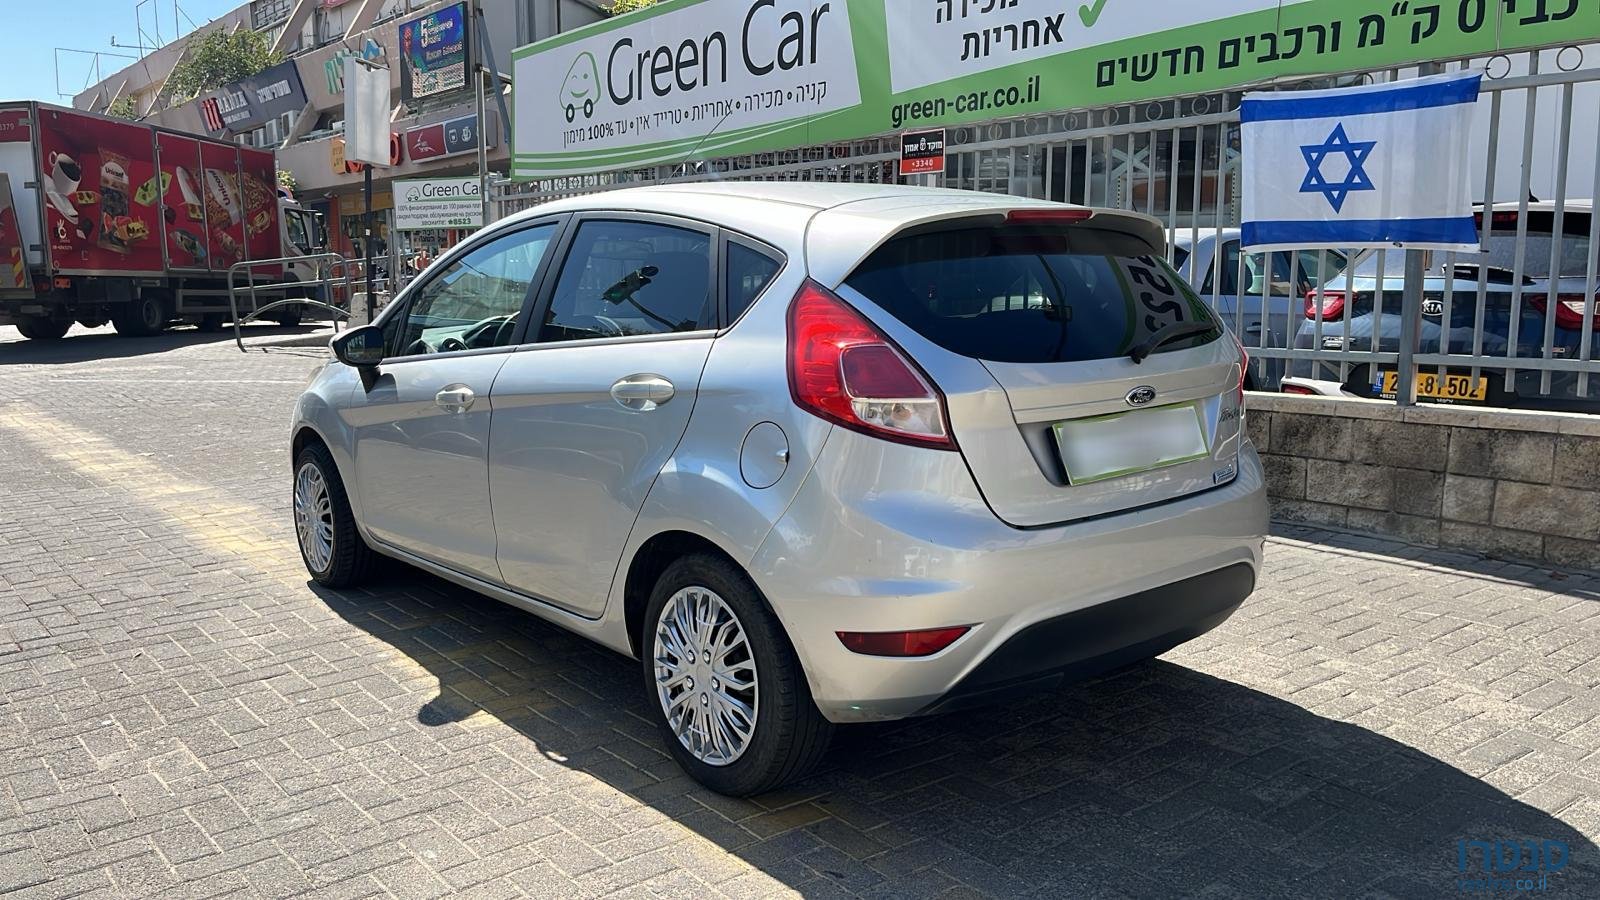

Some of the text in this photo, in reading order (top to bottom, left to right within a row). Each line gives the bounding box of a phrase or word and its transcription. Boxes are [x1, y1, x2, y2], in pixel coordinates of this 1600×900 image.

[606, 0, 830, 106] Green Car
[960, 13, 1066, 61] אחריות
[1217, 20, 1341, 69] ורכבים
[1096, 45, 1204, 88] חדשים
[562, 80, 827, 149] קניה מכירה אחריות טרייד אין עד 100% מימון
[891, 75, 1040, 128] green-car.co.il
[926, 140, 943, 152] מוקד
[422, 181, 481, 197] Green Ca
[448, 202, 456, 210] 100
